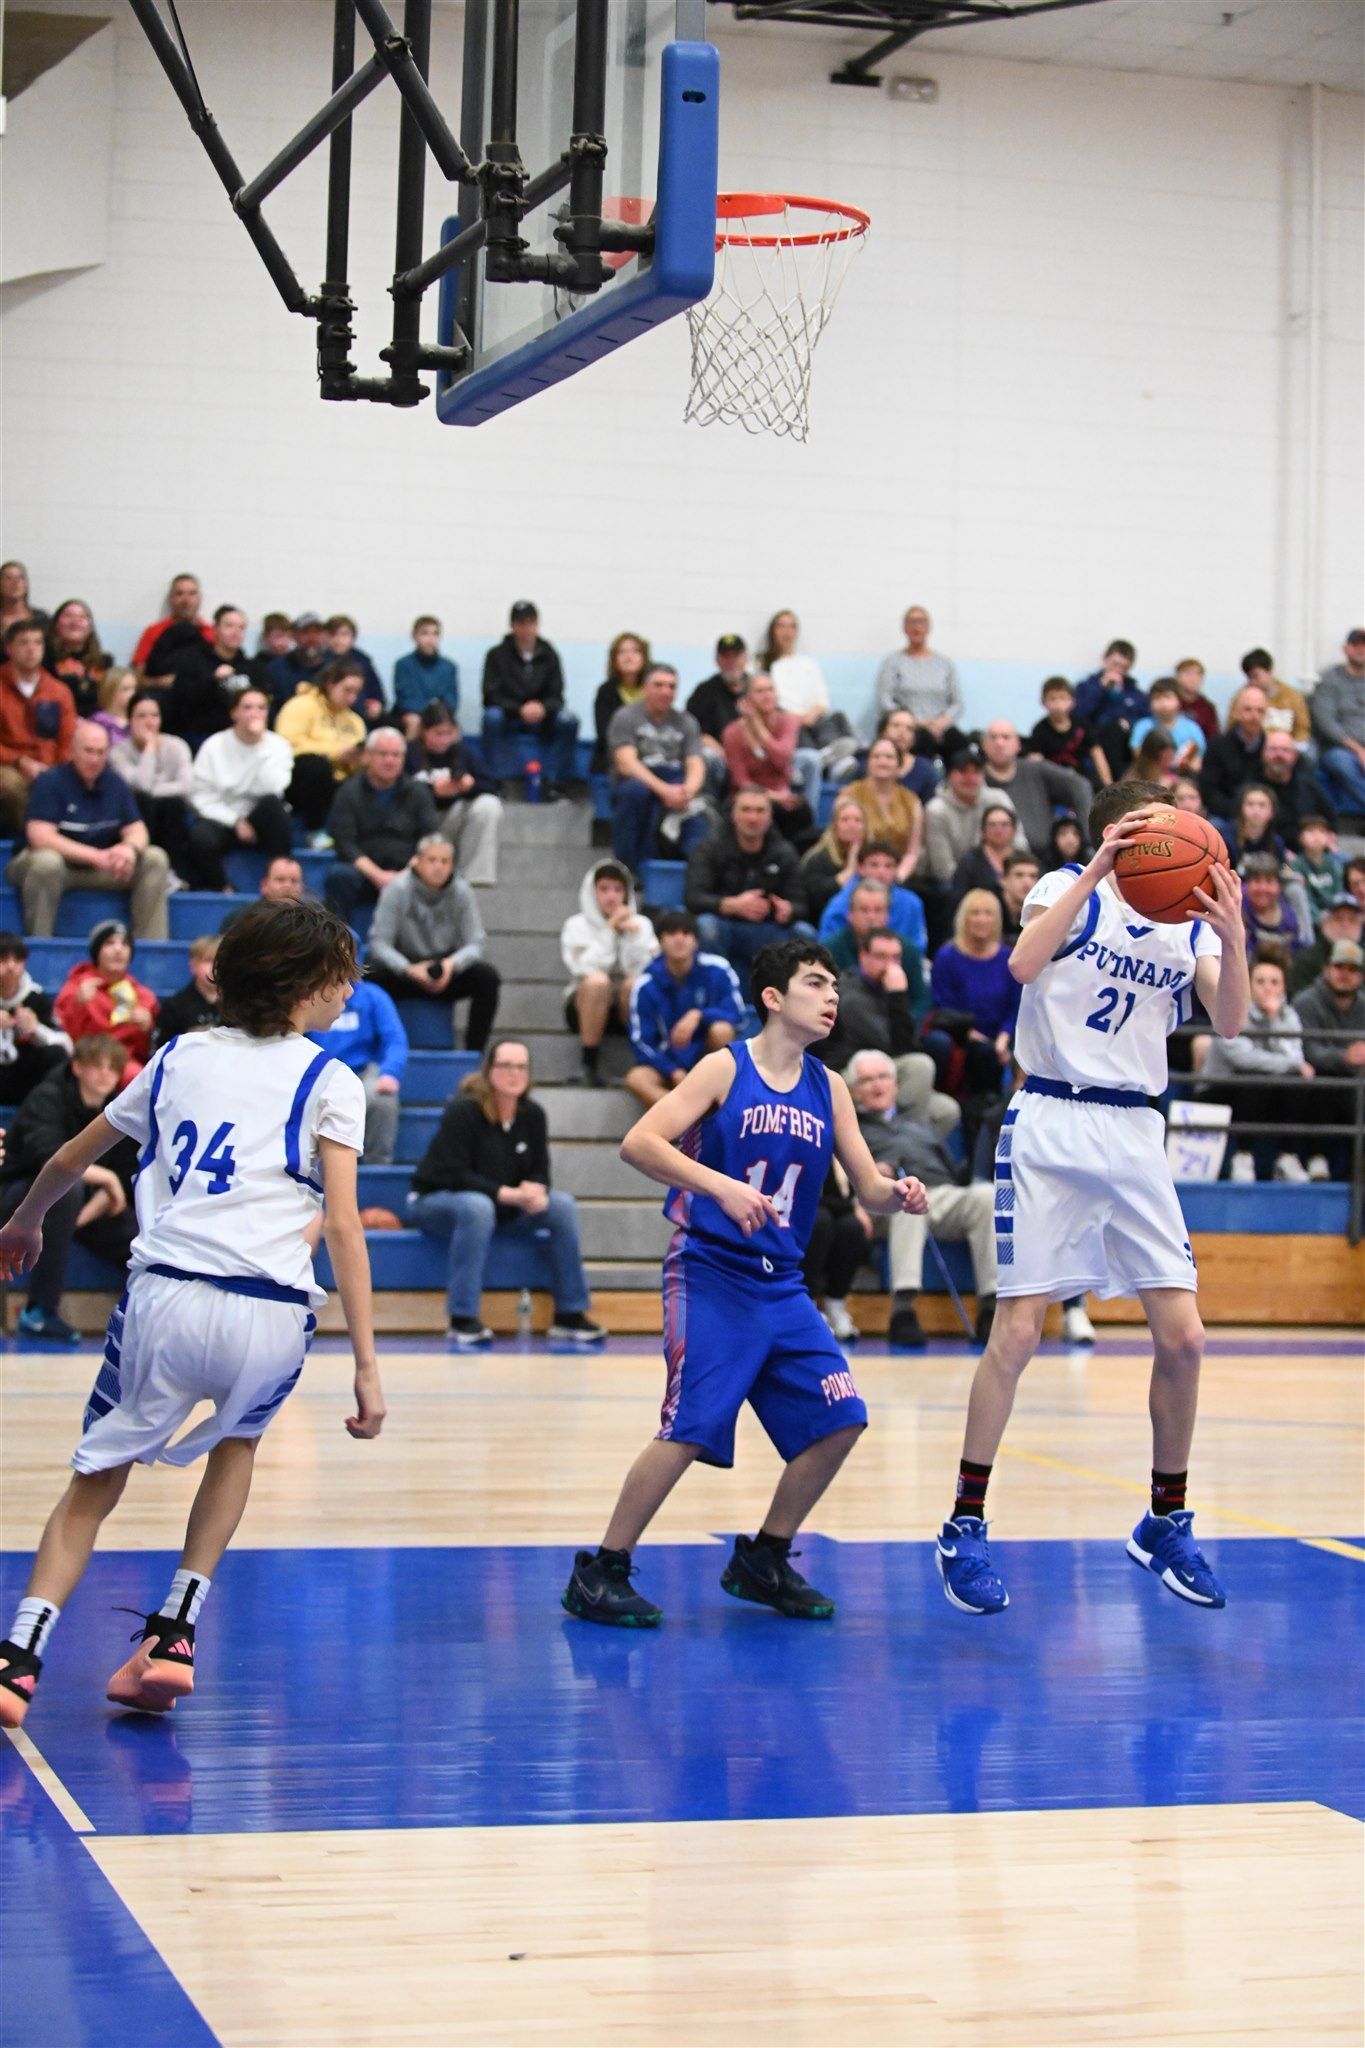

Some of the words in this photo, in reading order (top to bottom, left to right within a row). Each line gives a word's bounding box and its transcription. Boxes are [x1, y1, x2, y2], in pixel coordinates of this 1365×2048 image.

[1076, 940, 1187, 989] PUTNAM
[1085, 986, 1136, 1035] 21
[739, 1103, 825, 1148] POMFRET
[168, 1119, 236, 1196] 34
[745, 1160, 803, 1228] 14
[820, 1371, 857, 1407] POMF
